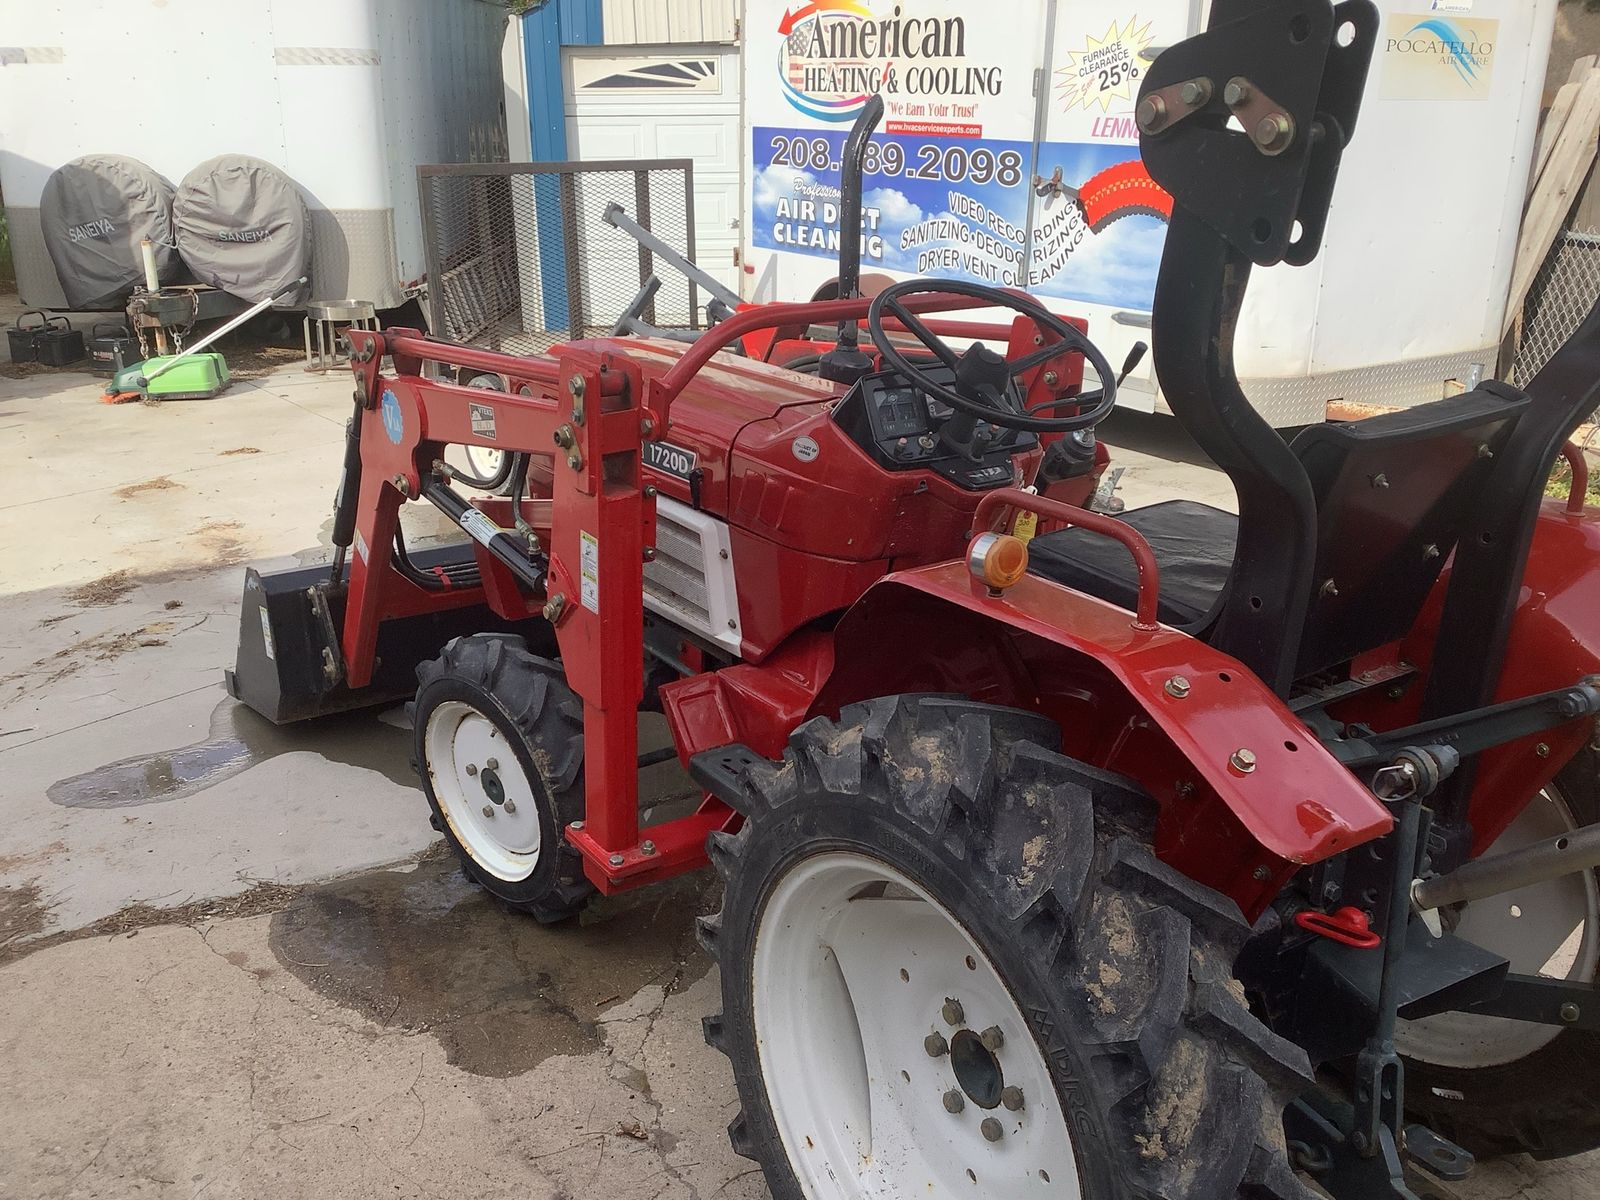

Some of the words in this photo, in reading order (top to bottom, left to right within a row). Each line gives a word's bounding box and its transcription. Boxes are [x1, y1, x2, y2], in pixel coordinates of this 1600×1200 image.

[806, 5, 966, 59] American
[1082, 40, 1122, 65] FURNACE
[1385, 39, 1493, 55] POCATELLO
[1438, 56, 1458, 65] AIR
[1079, 49, 1129, 77] CLEARANCE
[1098, 58, 1139, 92] 25%
[804, 66, 882, 94] HEATING
[887, 66, 900, 94] &
[905, 66, 1003, 96] COOLING
[905, 103, 926, 117] Earn
[928, 103, 949, 118] Your
[888, 123, 981, 135] www.hvacserviceexperts.com
[1091, 117, 1139, 139] LENN
[771, 135, 1023, 187] 208.89.2098
[793, 177, 843, 200] Profession
[776, 198, 816, 222] AIR
[823, 203, 880, 230] DT
[948, 190, 988, 225] VIDEO
[68, 218, 115, 243] SANEIYA
[218, 229, 274, 243] SANEIYA
[773, 222, 883, 258] CLEANG
[918, 248, 960, 275] DRYER
[962, 252, 999, 283] VENT
[649, 443, 689, 474] 1720D
